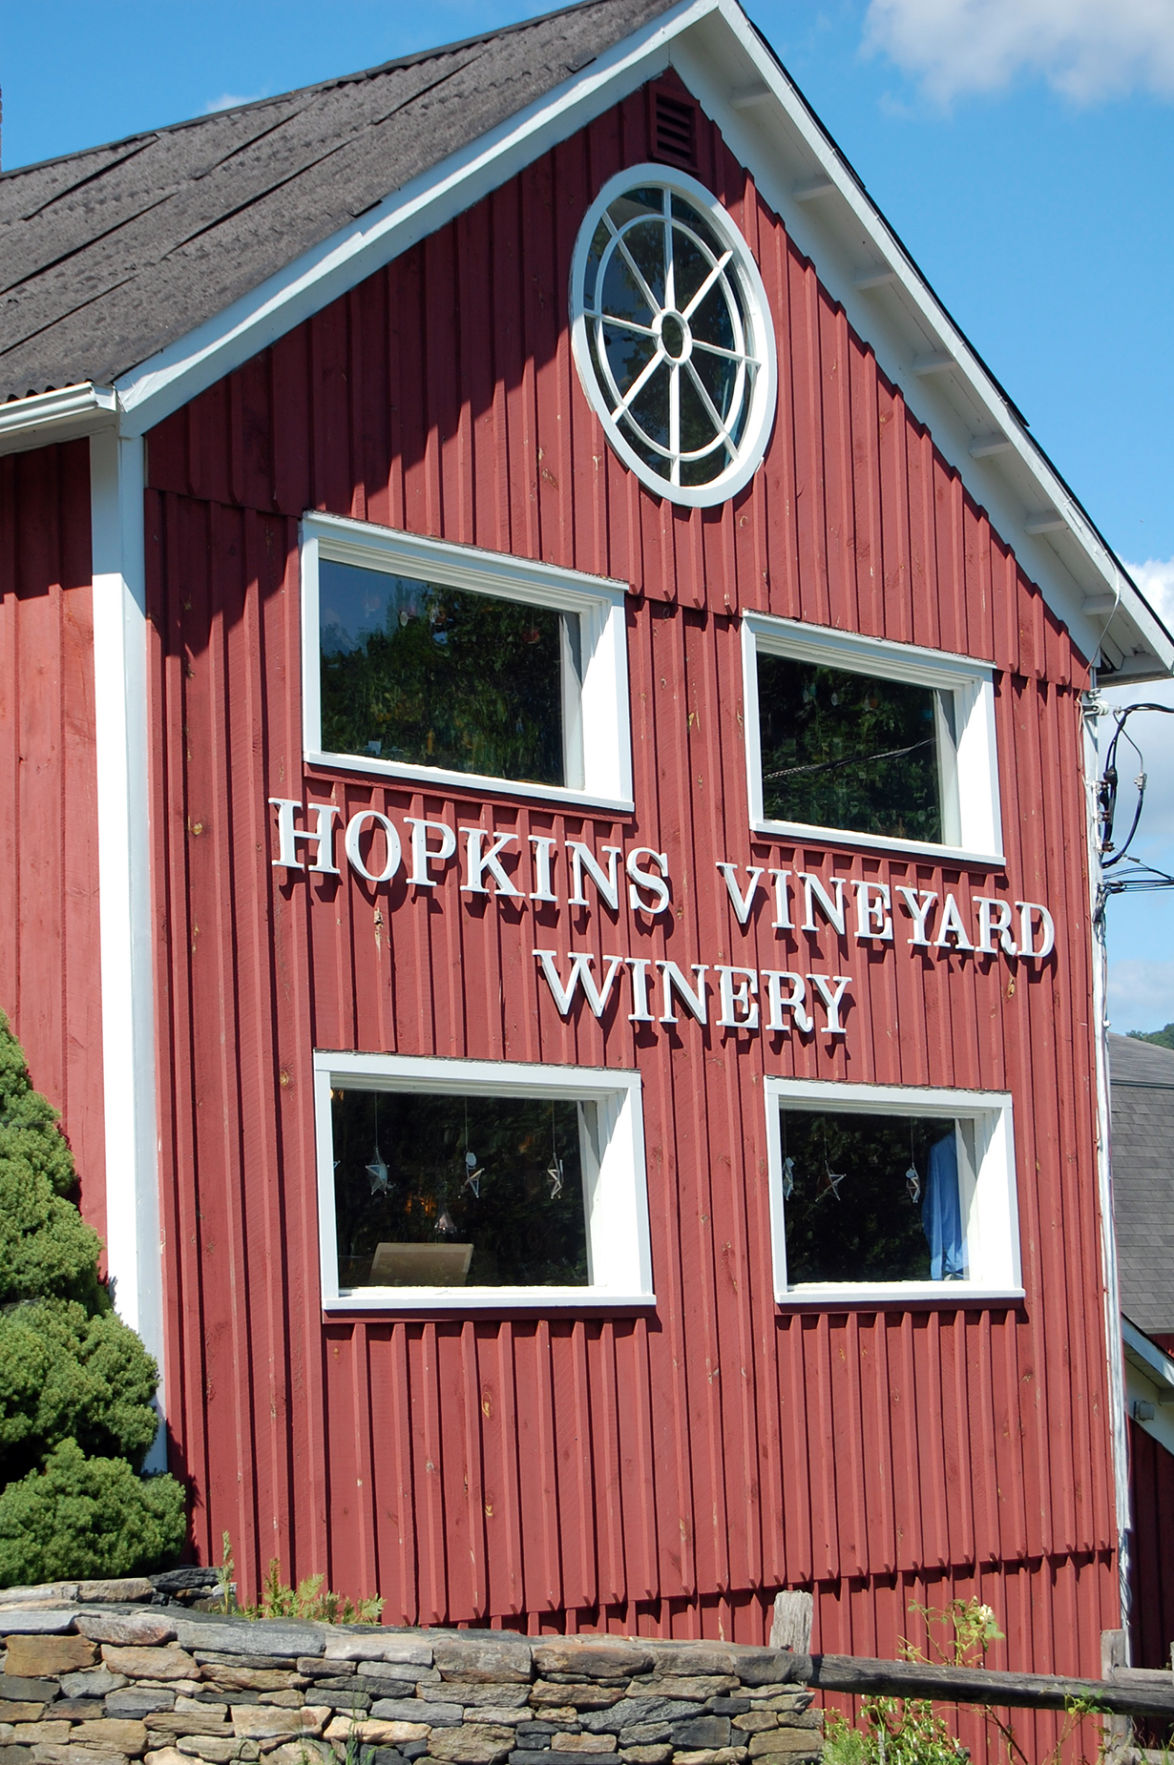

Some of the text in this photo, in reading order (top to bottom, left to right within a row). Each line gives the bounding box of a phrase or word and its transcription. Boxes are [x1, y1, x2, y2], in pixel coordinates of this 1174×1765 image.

[268, 797, 1055, 958] HOPKINS VINEYARD
[532, 949, 852, 1034] WINERY
